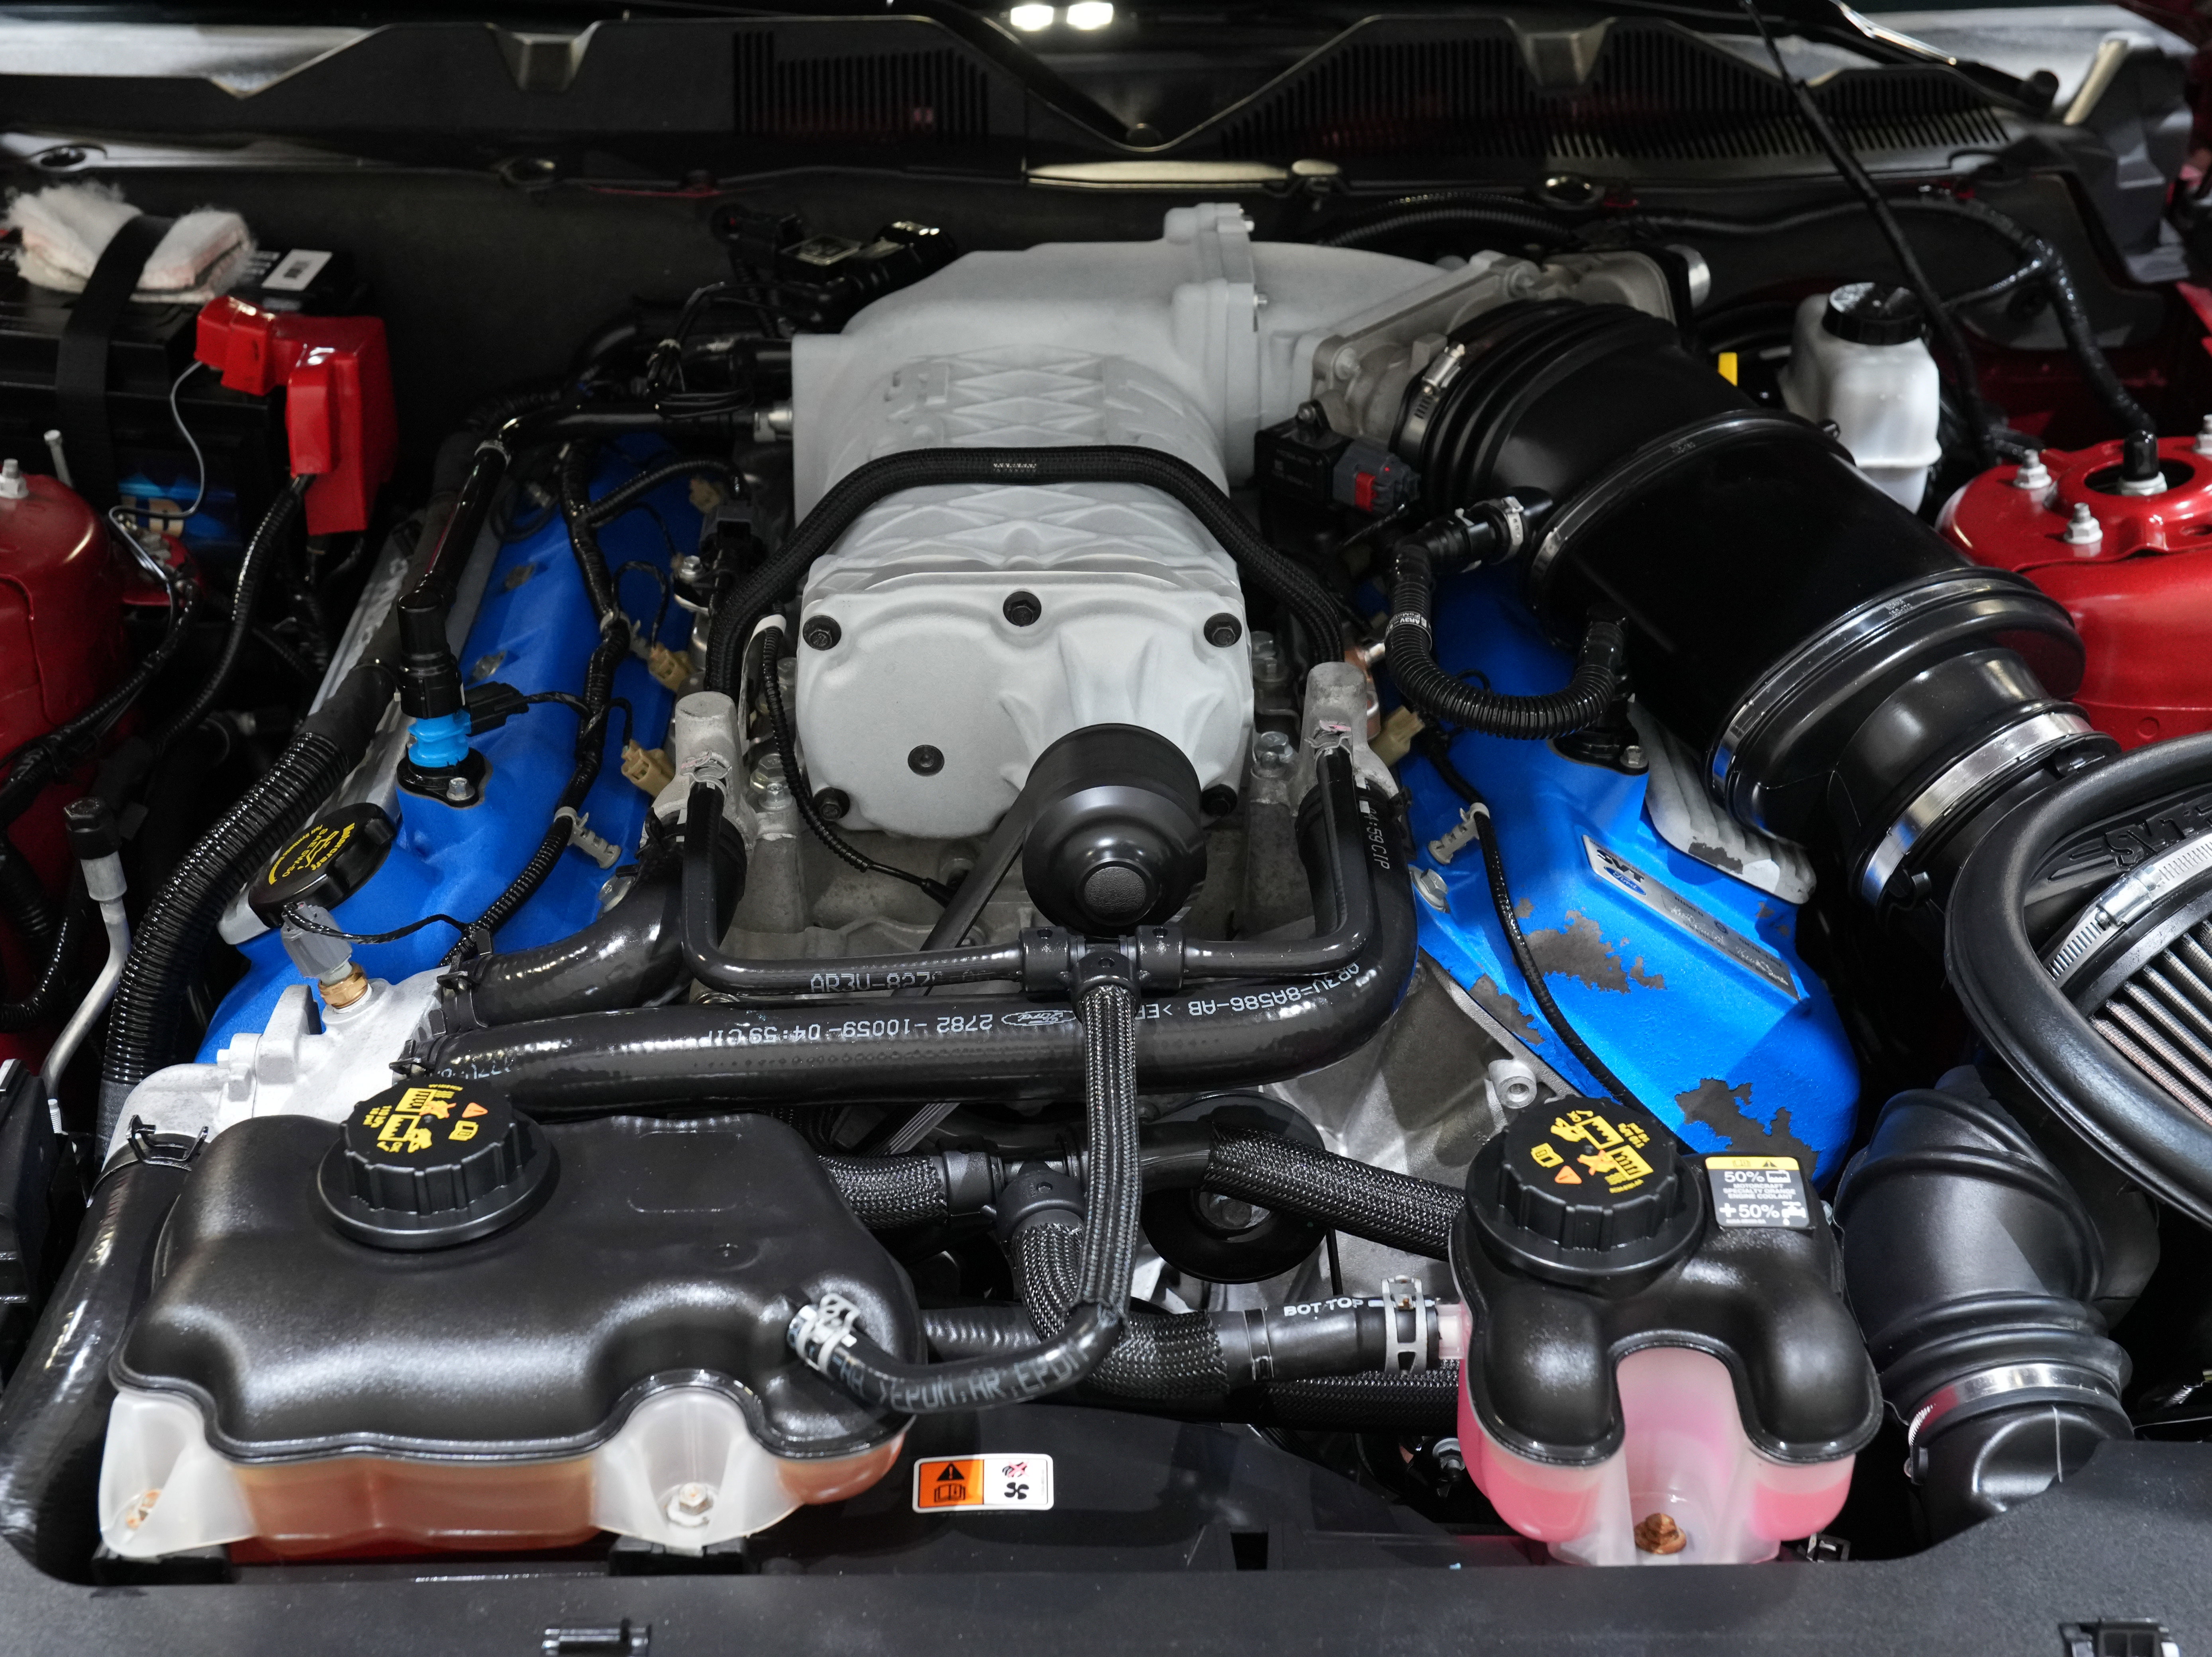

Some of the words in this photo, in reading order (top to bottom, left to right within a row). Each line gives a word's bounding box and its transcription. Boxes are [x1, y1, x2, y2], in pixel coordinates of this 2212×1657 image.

[307, 828, 328, 849] SAE
[310, 822, 355, 871] Motorcraft
[1597, 849, 1645, 883] SVT
[937, 1013, 994, 1032] 2782
[1724, 1171, 1765, 1183] 50%
[1283, 1302, 1322, 1317] BOT
[1325, 1297, 1364, 1311] TOP
